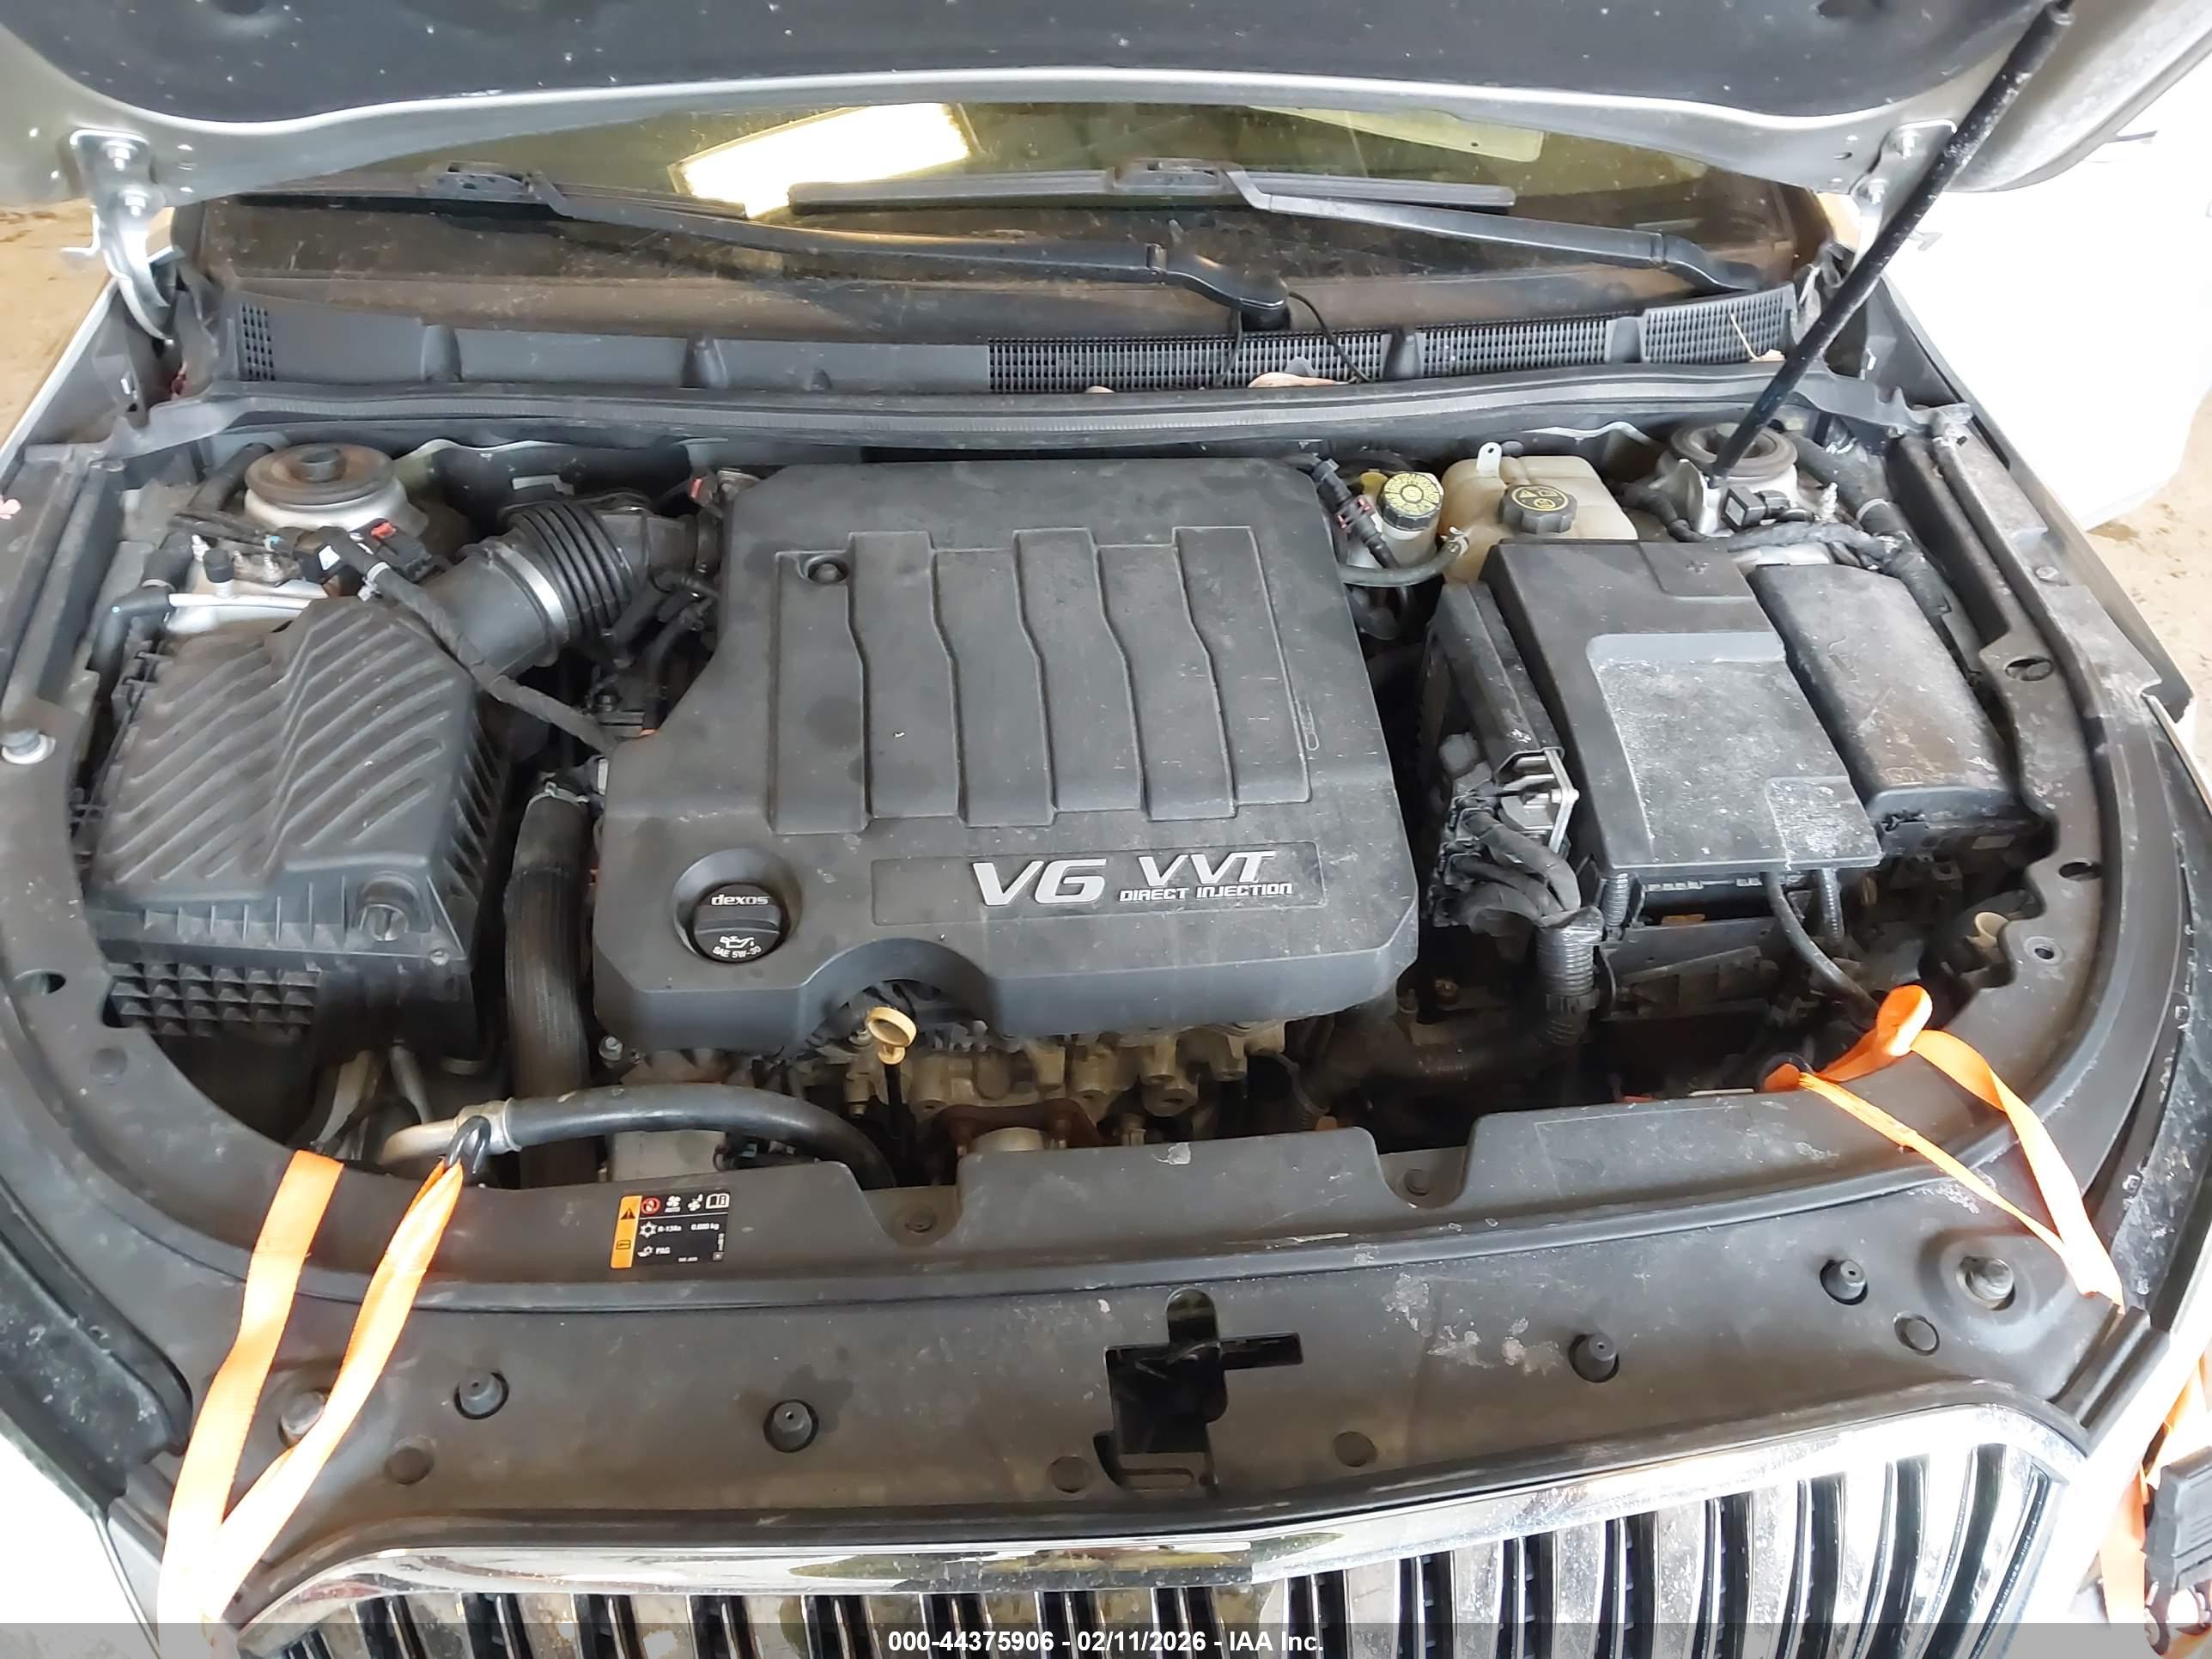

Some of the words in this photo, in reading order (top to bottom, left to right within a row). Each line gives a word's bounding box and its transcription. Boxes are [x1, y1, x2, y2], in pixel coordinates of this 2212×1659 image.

[972, 858, 1107, 906] V6
[1138, 851, 1276, 886] VVT
[711, 894, 770, 905] dexos
[1119, 888, 1189, 902] DIRECT
[1195, 883, 1292, 898] INJECTION
[712, 946, 731, 957] SAE
